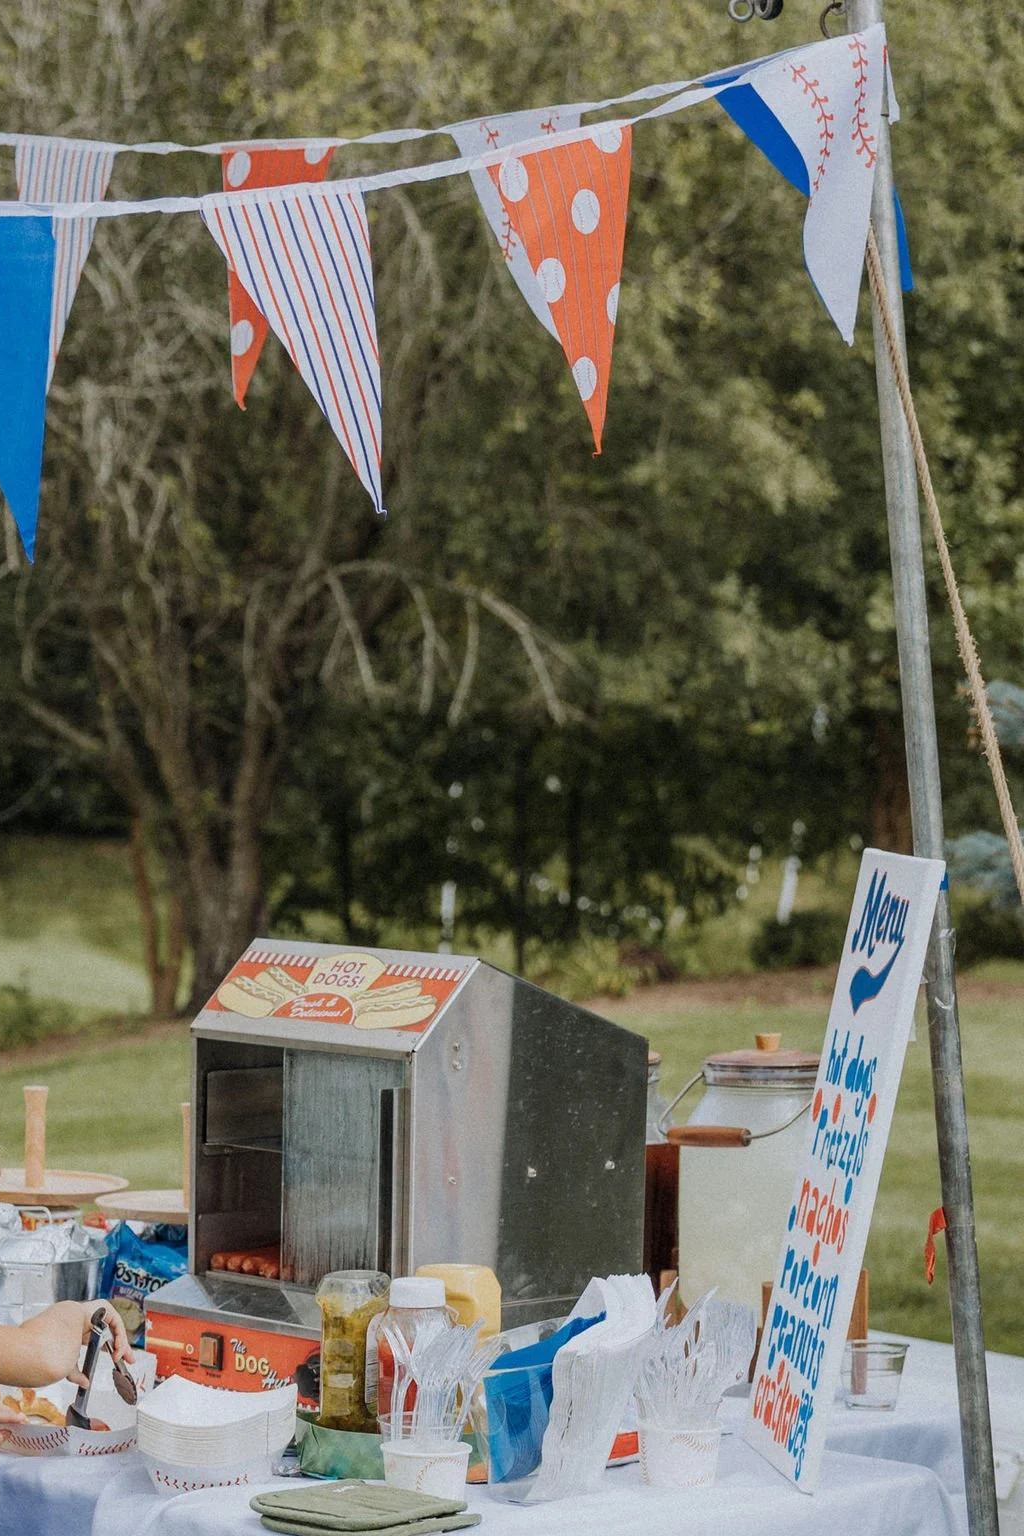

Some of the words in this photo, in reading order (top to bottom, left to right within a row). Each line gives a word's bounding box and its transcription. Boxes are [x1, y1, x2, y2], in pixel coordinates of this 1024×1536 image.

[851, 868, 910, 959] Menu
[330, 961, 367, 974] HOT
[312, 973, 365, 989] DOGS!
[826, 1028, 851, 1086] hot
[844, 1034, 878, 1118] dogs
[795, 1177, 849, 1255] nachos
[229, 1338, 248, 1354] The
[234, 1355, 270, 1375] DOG
